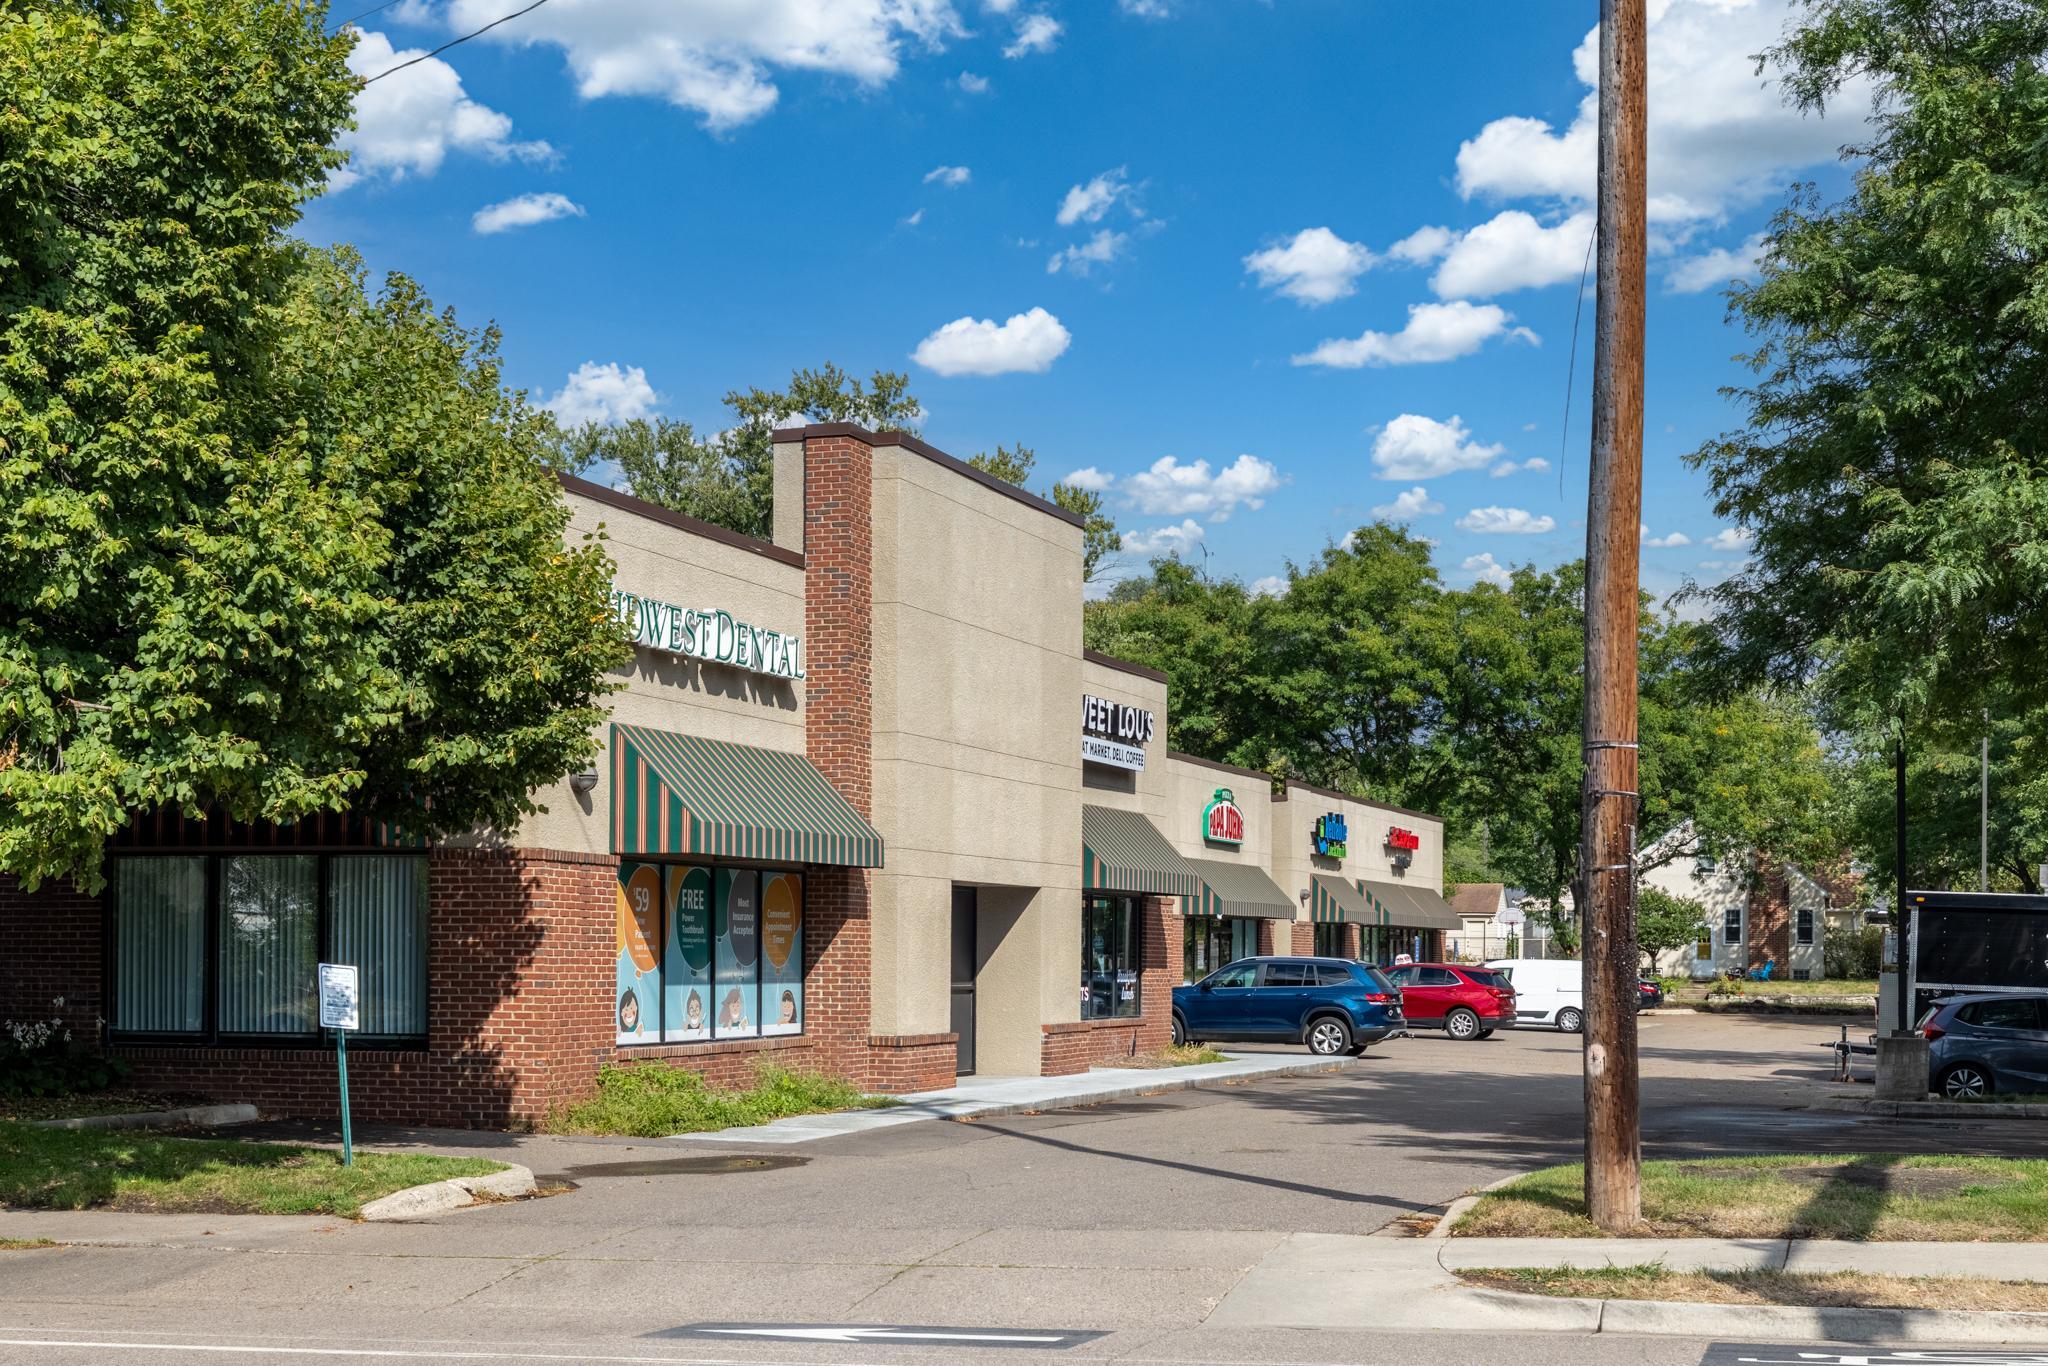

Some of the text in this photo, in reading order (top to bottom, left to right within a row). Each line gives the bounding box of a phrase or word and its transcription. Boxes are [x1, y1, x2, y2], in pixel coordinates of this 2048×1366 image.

[608, 582, 805, 681] IDWEST DENTAL
[1119, 705, 1154, 743] LOU'S
[1126, 750, 1144, 767] COFFEE
[1209, 805, 1224, 838] PAPA
[682, 888, 704, 910] FREE
[681, 912, 696, 922] Power
[732, 911, 755, 921] Insurance
[681, 924, 705, 935] Toothbrush
[732, 925, 755, 937] Accepted
[765, 922, 793, 934] Appointment
